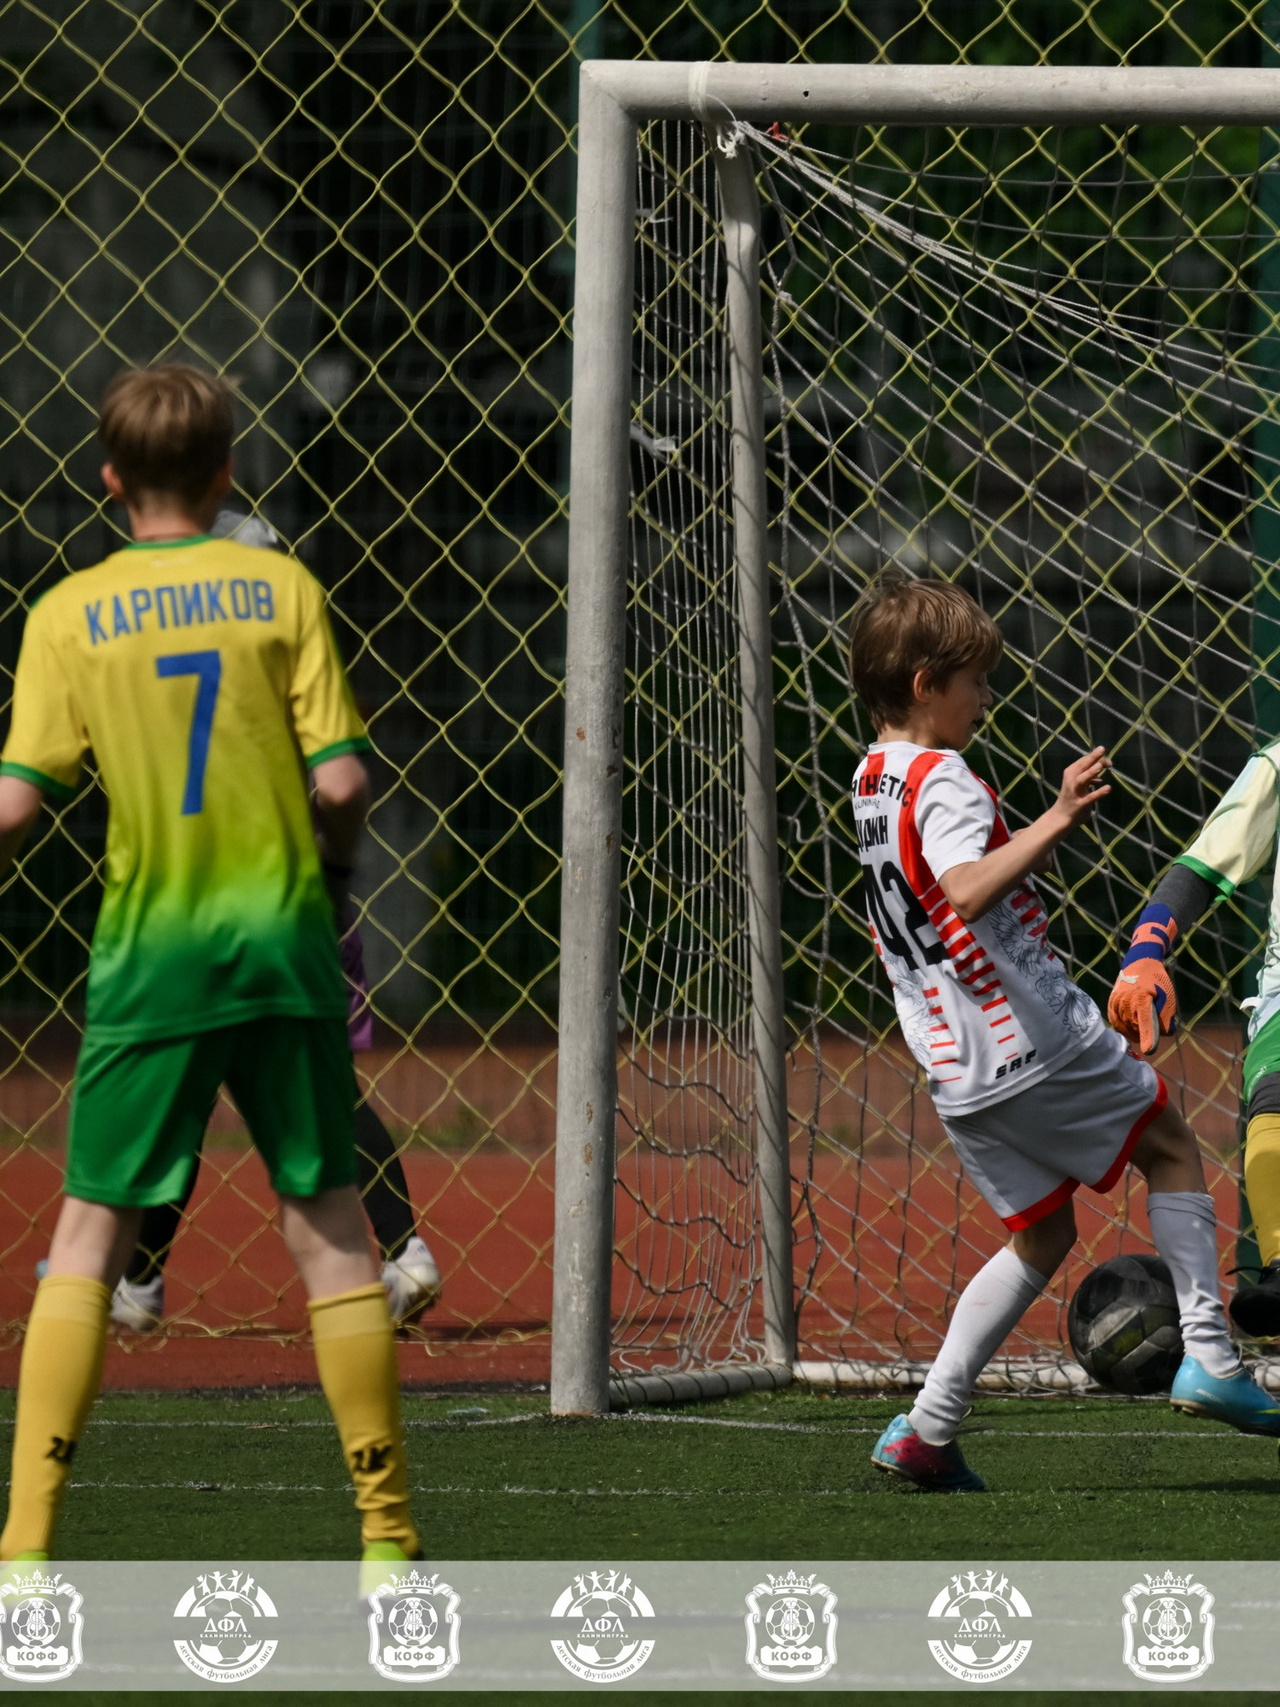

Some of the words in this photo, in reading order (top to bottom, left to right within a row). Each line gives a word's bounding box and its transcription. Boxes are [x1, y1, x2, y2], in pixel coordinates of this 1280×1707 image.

[85, 578, 276, 646] КАРПИКОВ
[155, 649, 222, 816] 7
[862, 860, 951, 971] 42
